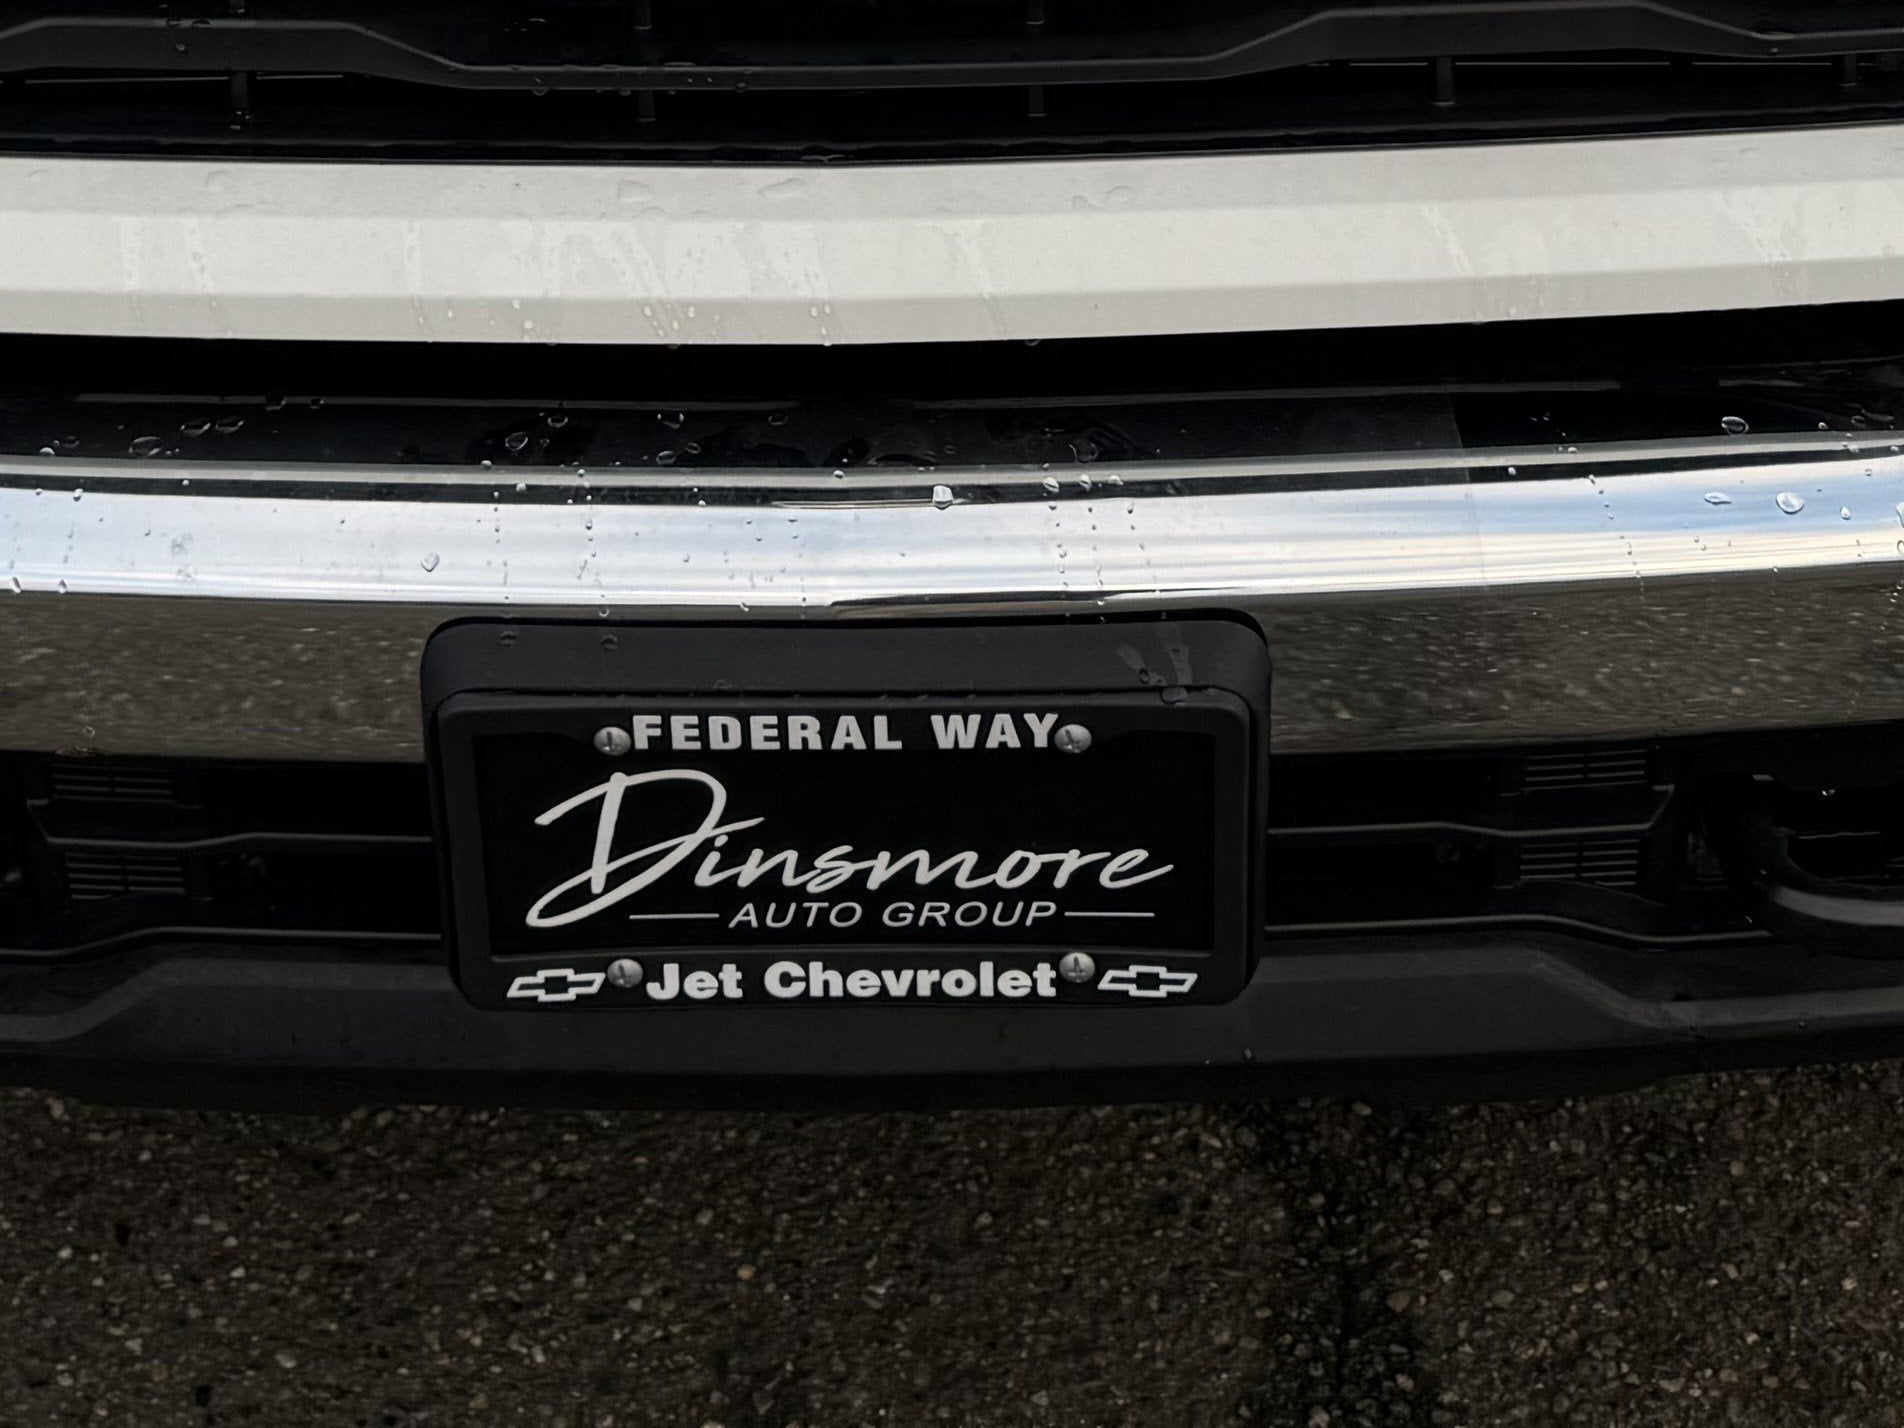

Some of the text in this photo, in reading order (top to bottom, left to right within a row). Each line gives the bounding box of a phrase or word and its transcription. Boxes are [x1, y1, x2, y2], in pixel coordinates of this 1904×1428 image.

[631, 712, 1060, 751] FEDERAL WAY
[524, 769, 1175, 930] Dinsmore
[727, 900, 1058, 930] AUTO GROUP
[645, 961, 1057, 1002] Jet Chevrolet
